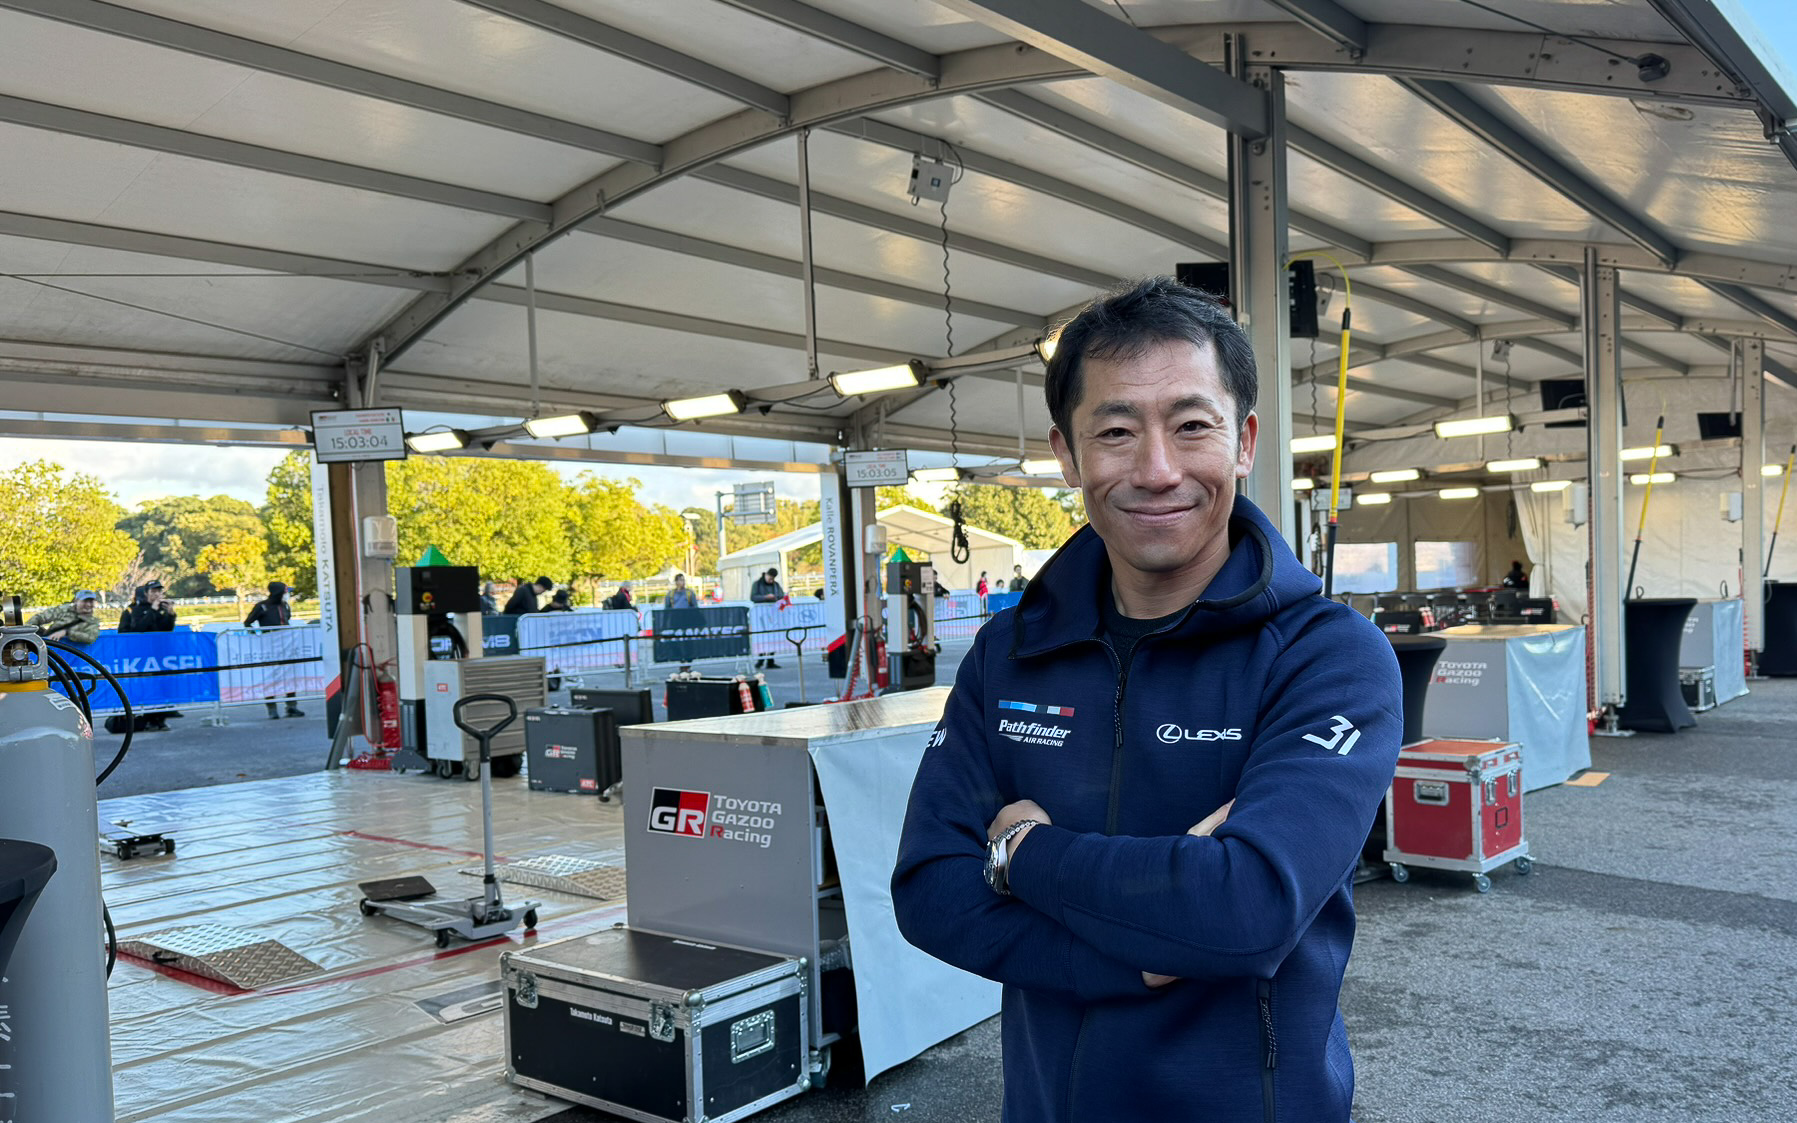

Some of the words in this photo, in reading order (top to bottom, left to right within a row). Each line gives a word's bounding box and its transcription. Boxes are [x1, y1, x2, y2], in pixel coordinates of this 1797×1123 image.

[331, 435, 388, 449] 15:03:04
[857, 467, 897, 478] 15:03:05
[826, 498, 834, 523] Kalle
[322, 559, 333, 633] KATSUTA
[1437, 668, 1482, 677] GAZOO
[1438, 661, 1487, 669] TOYOTA
[1436, 676, 1480, 687] Racing
[999, 719, 1071, 739] Pathfinder
[1184, 728, 1242, 741] LEXUS
[1301, 715, 1361, 756] 31
[1023, 736, 1036, 744] AIR
[1037, 738, 1064, 747] RACING
[713, 795, 782, 815] TOYOTA
[651, 806, 704, 835] GR
[711, 810, 775, 829] GAZOO
[710, 825, 772, 849] Racing
